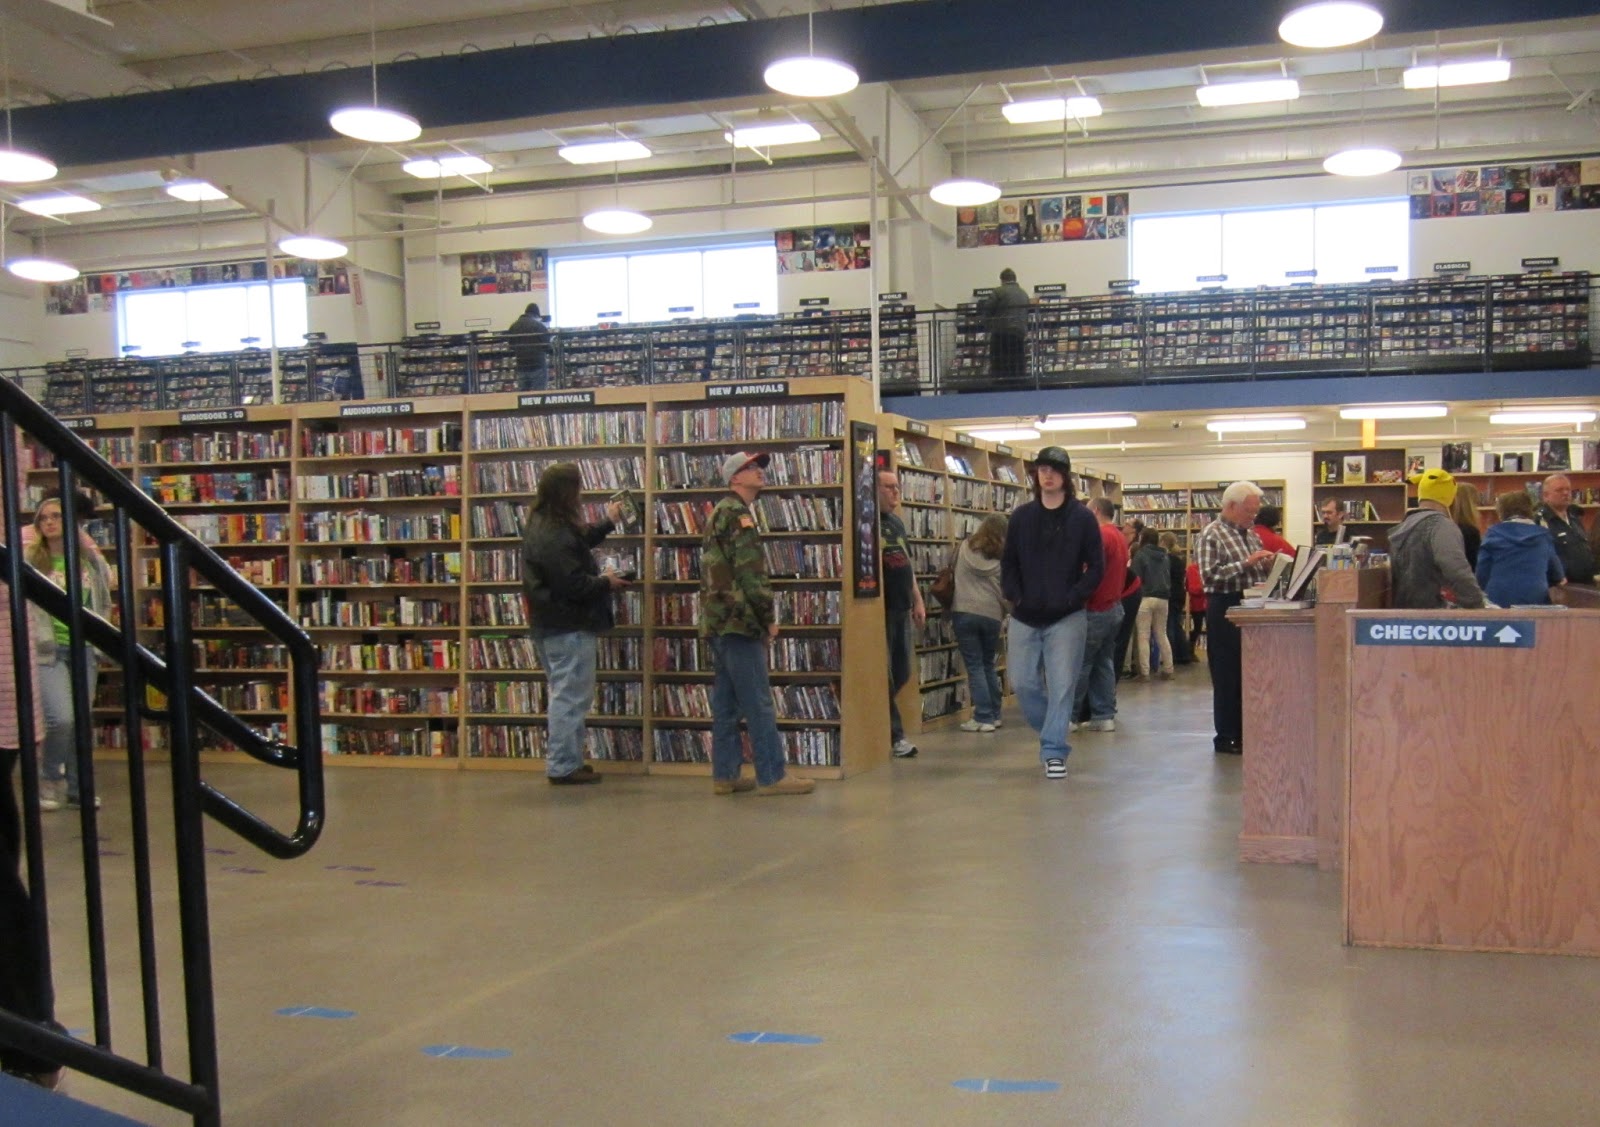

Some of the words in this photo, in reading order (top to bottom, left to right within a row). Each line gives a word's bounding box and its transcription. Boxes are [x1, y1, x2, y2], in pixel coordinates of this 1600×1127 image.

[1435, 262, 1469, 270] CLASSICAL
[708, 386, 732, 396] NEW
[735, 383, 784, 395] ARRIVALS
[521, 396, 542, 406] NEW
[545, 394, 591, 404] ARRIVALS
[181, 412, 227, 422] AUDIOBOOKS
[234, 410, 244, 419] CD
[342, 406, 392, 416] AUDIOBOOKS
[399, 404, 410, 412] CD
[84, 419, 93, 427] CD
[1370, 624, 1487, 641] CHECKOUT
